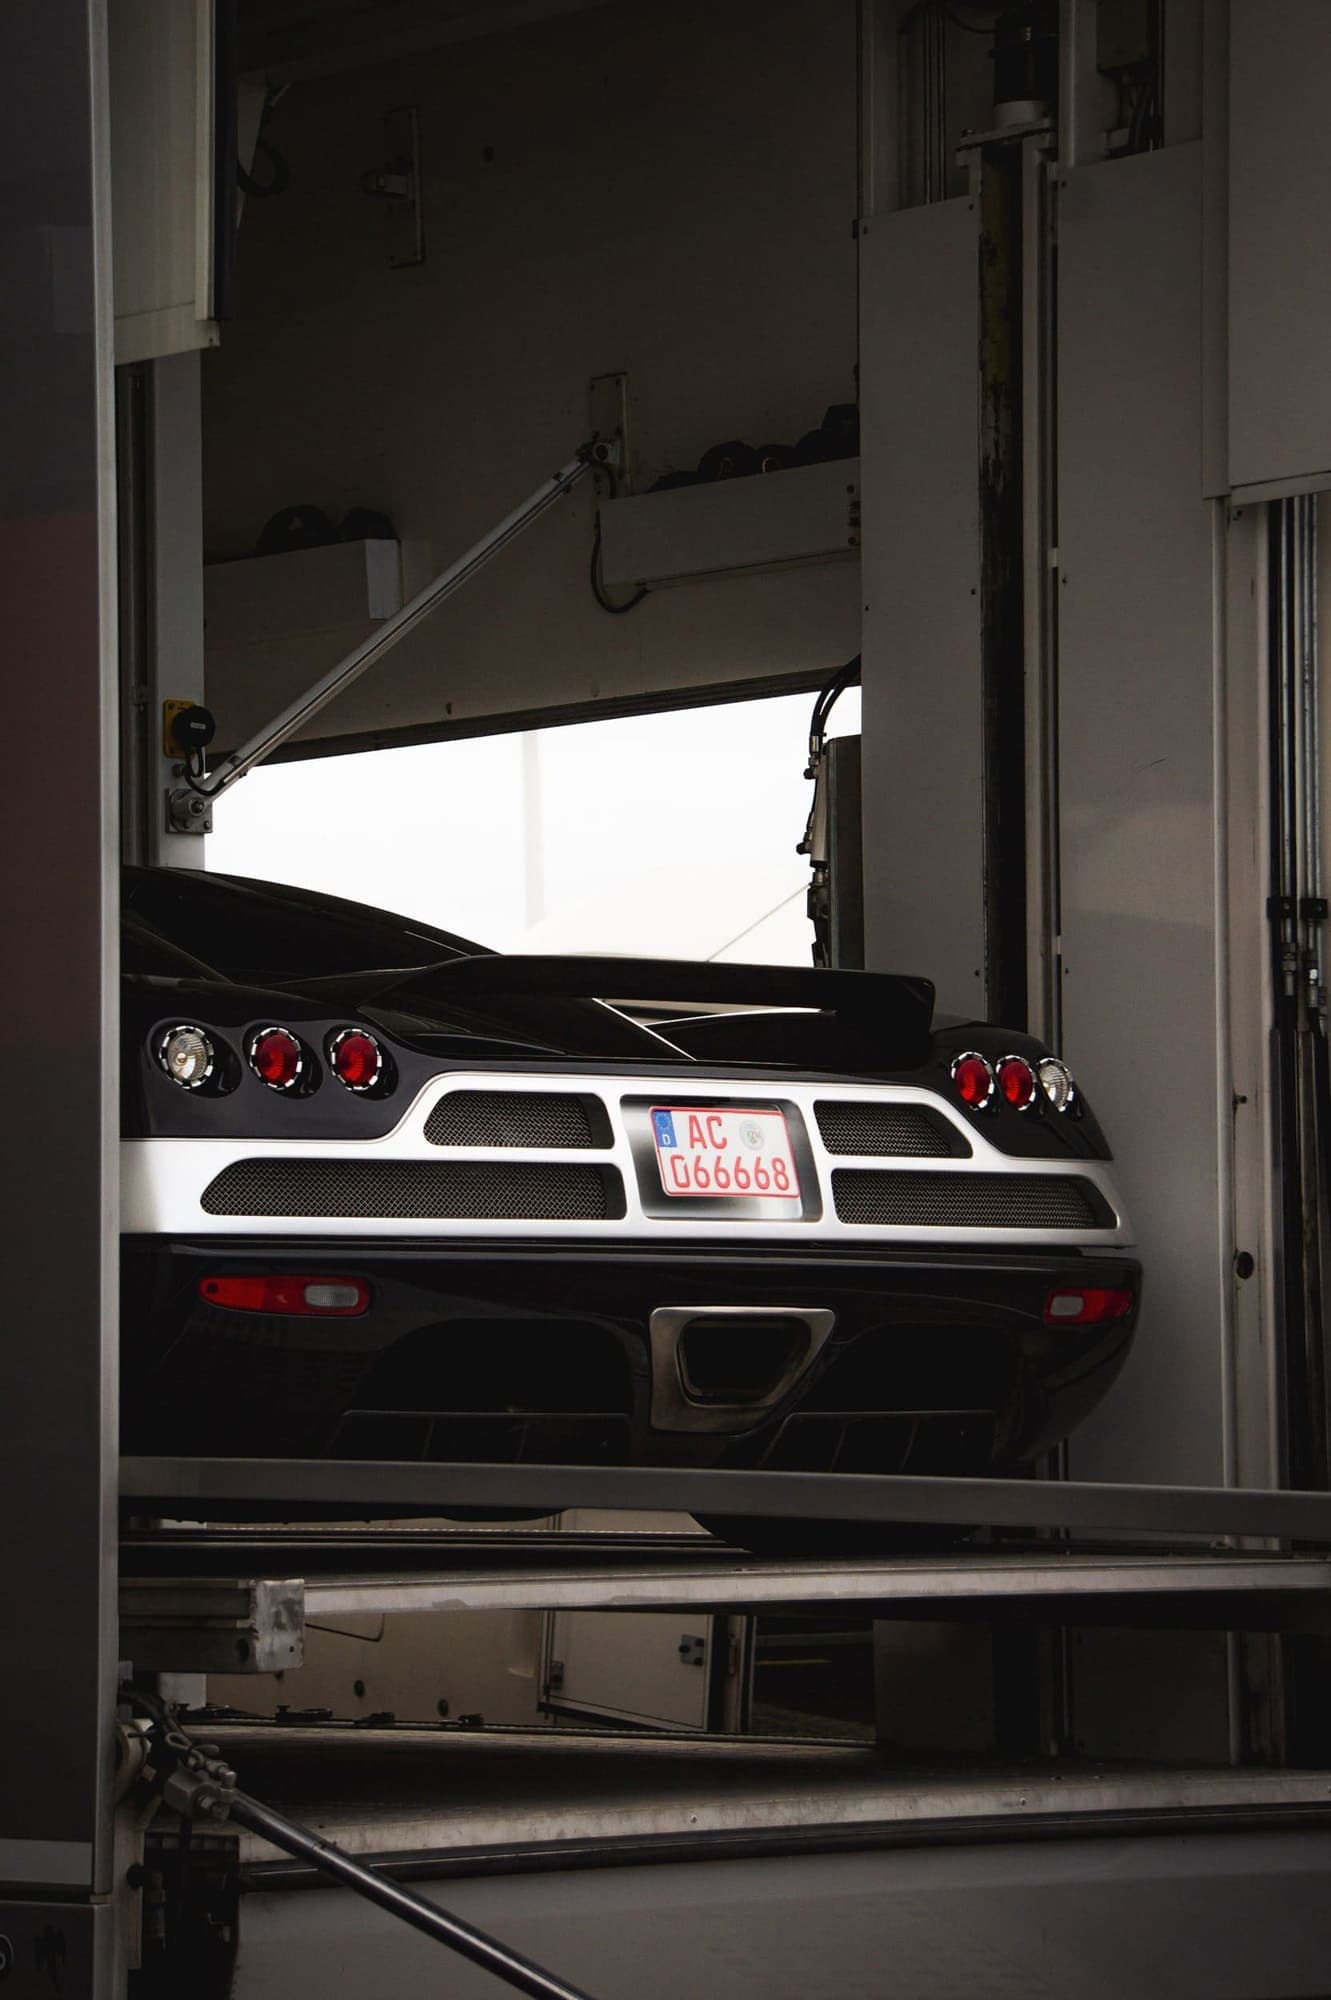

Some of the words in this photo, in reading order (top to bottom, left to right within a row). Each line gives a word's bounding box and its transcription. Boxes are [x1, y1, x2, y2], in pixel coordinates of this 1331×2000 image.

[661, 1133, 672, 1145] D
[688, 1114, 728, 1150] AC
[669, 1154, 790, 1191] 066668
